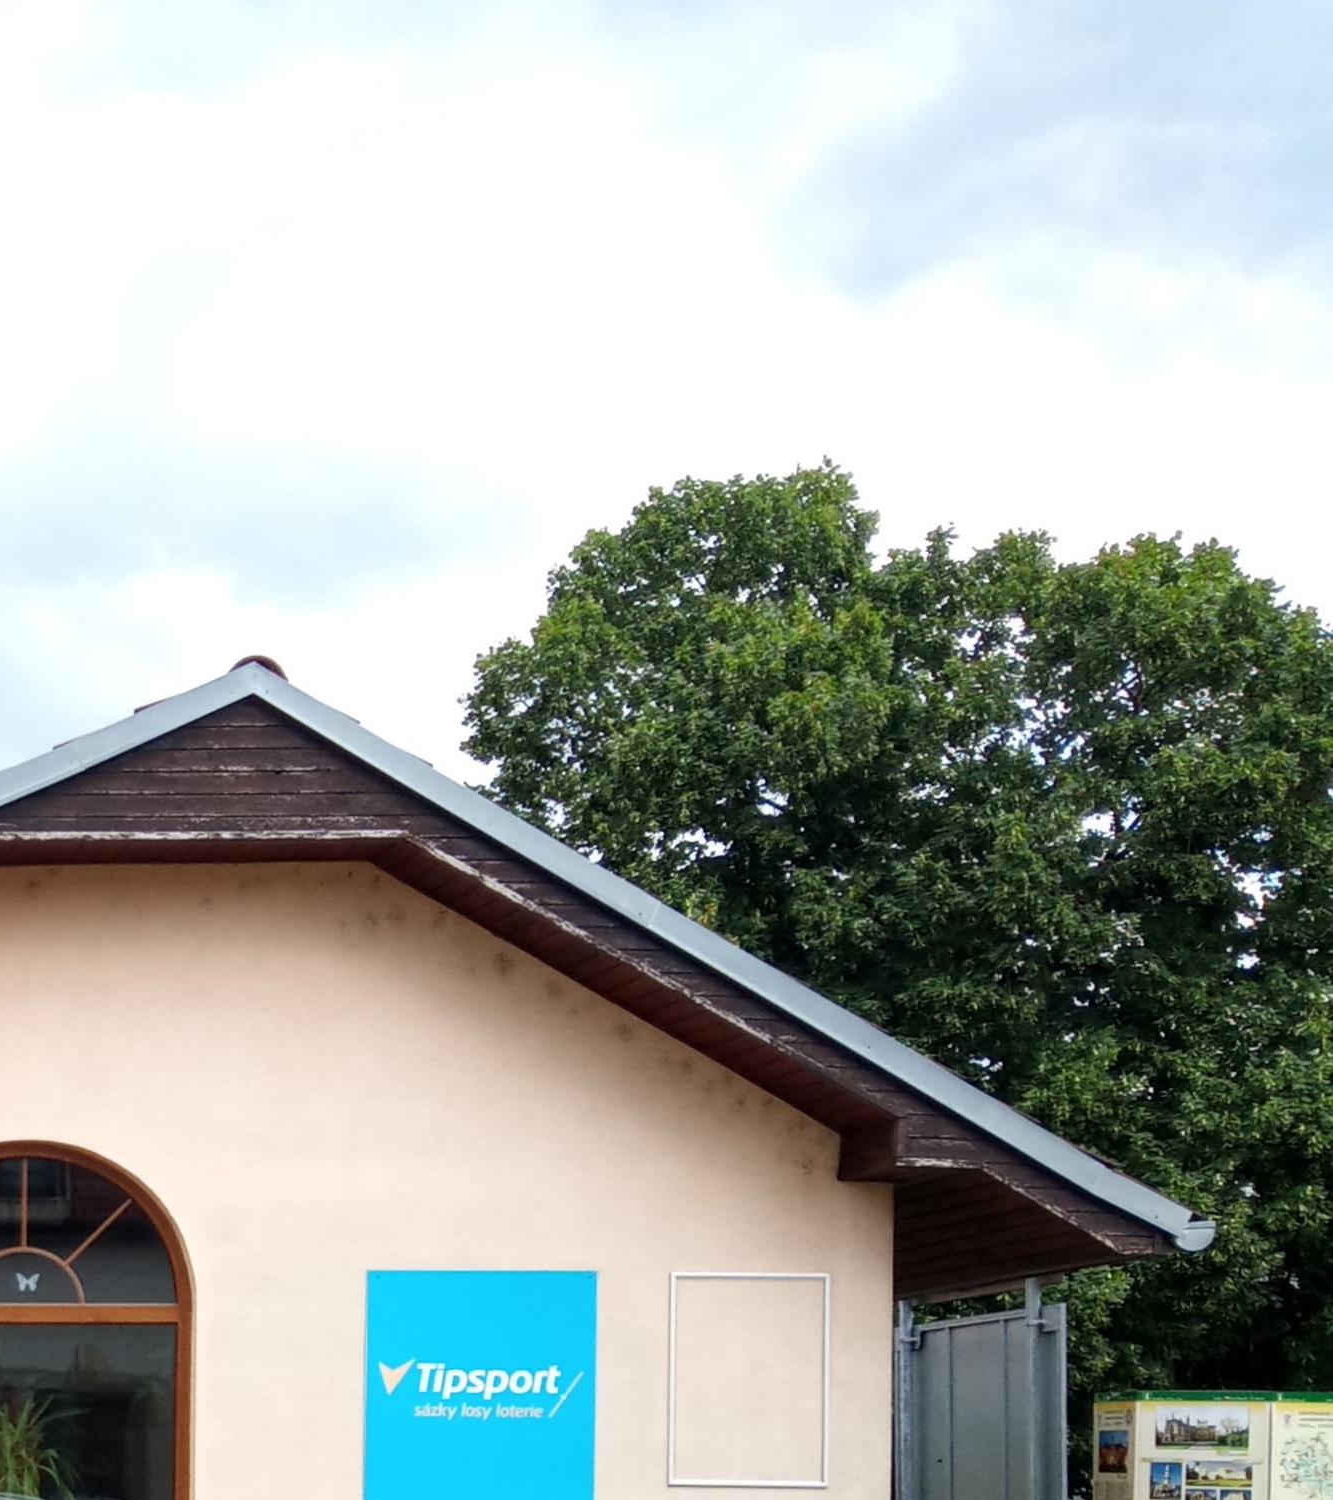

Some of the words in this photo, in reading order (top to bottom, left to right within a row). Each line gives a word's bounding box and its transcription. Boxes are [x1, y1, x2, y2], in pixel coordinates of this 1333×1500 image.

[416, 1363, 562, 1400] Tipsport
[414, 1402, 459, 1421] sázky
[461, 1402, 493, 1421] losy
